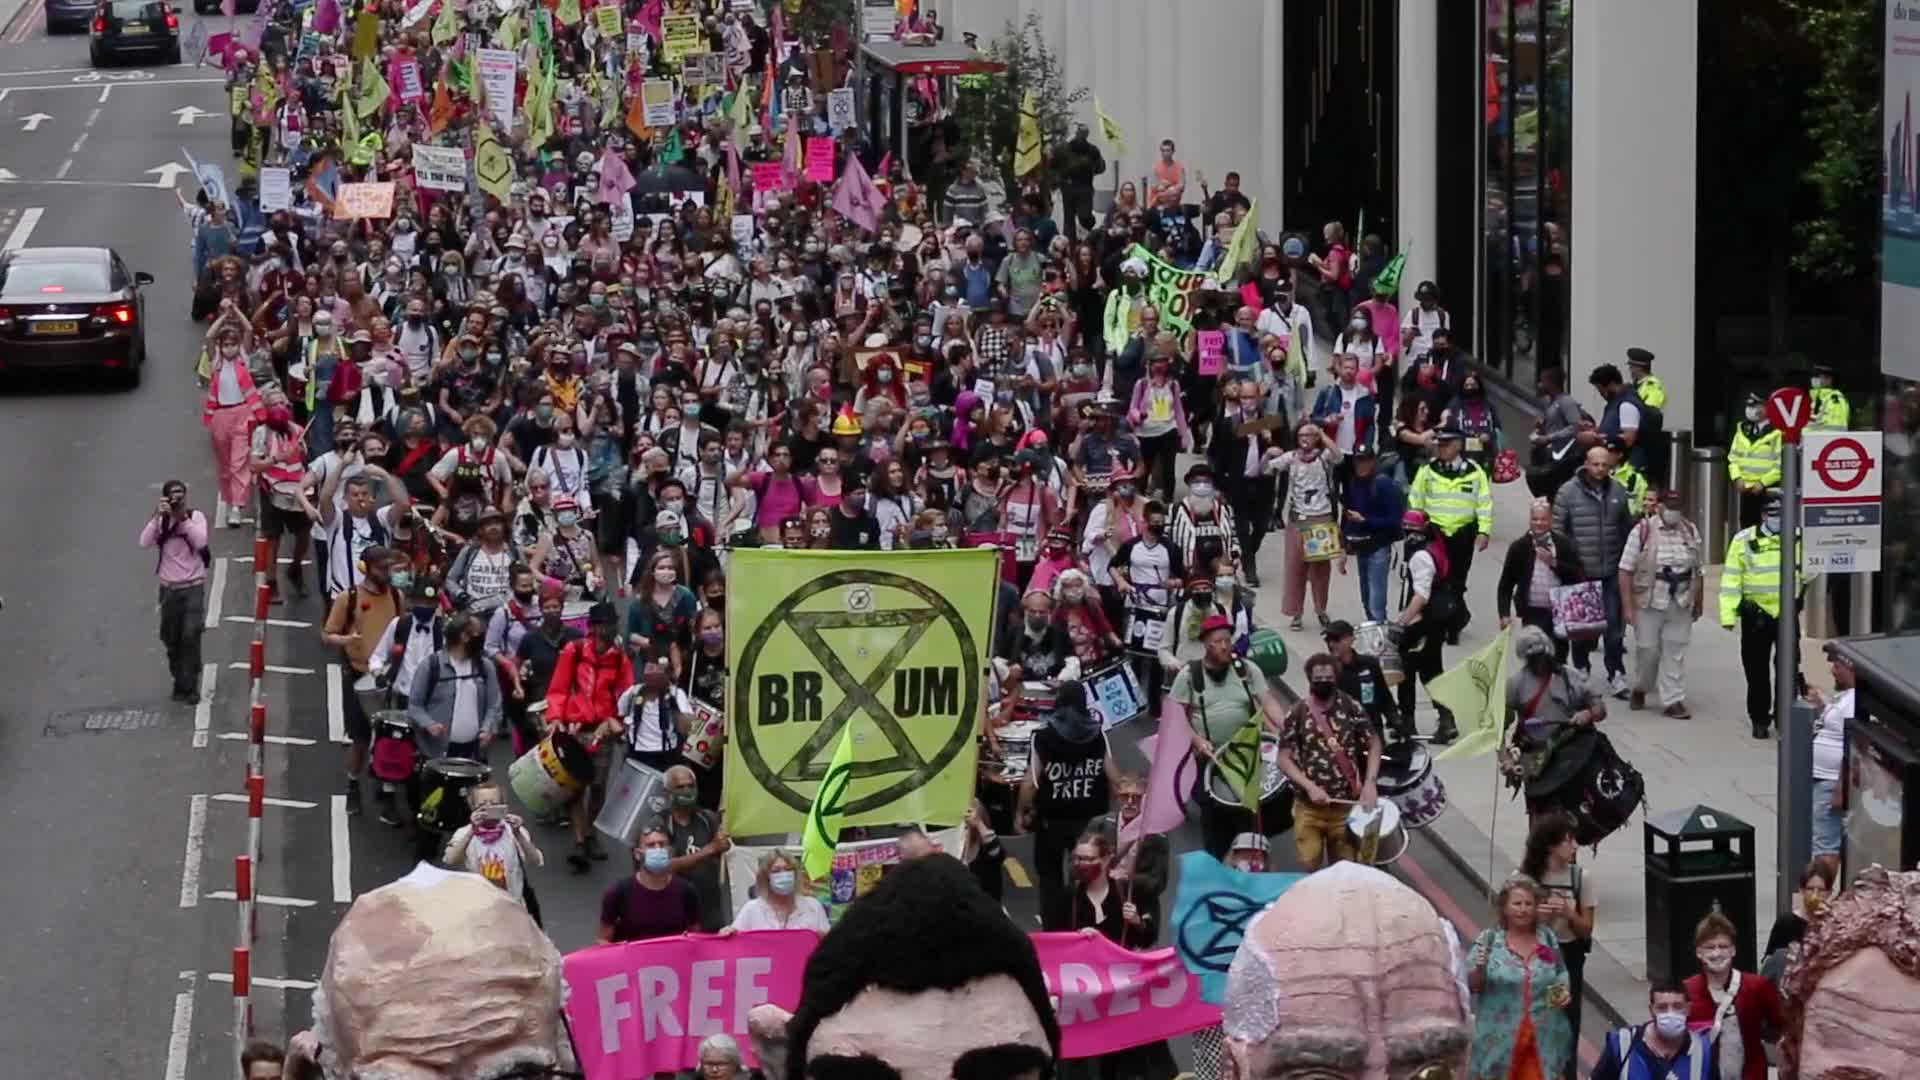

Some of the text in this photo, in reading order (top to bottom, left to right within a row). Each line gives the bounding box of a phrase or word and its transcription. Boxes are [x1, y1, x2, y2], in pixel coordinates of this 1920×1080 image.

[1774, 396, 1802, 428] V
[1824, 459, 1863, 469] BUS STOP
[1045, 762, 1072, 781] YOU
[1052, 778, 1097, 799] FREE
[595, 956, 773, 1056] FREE
